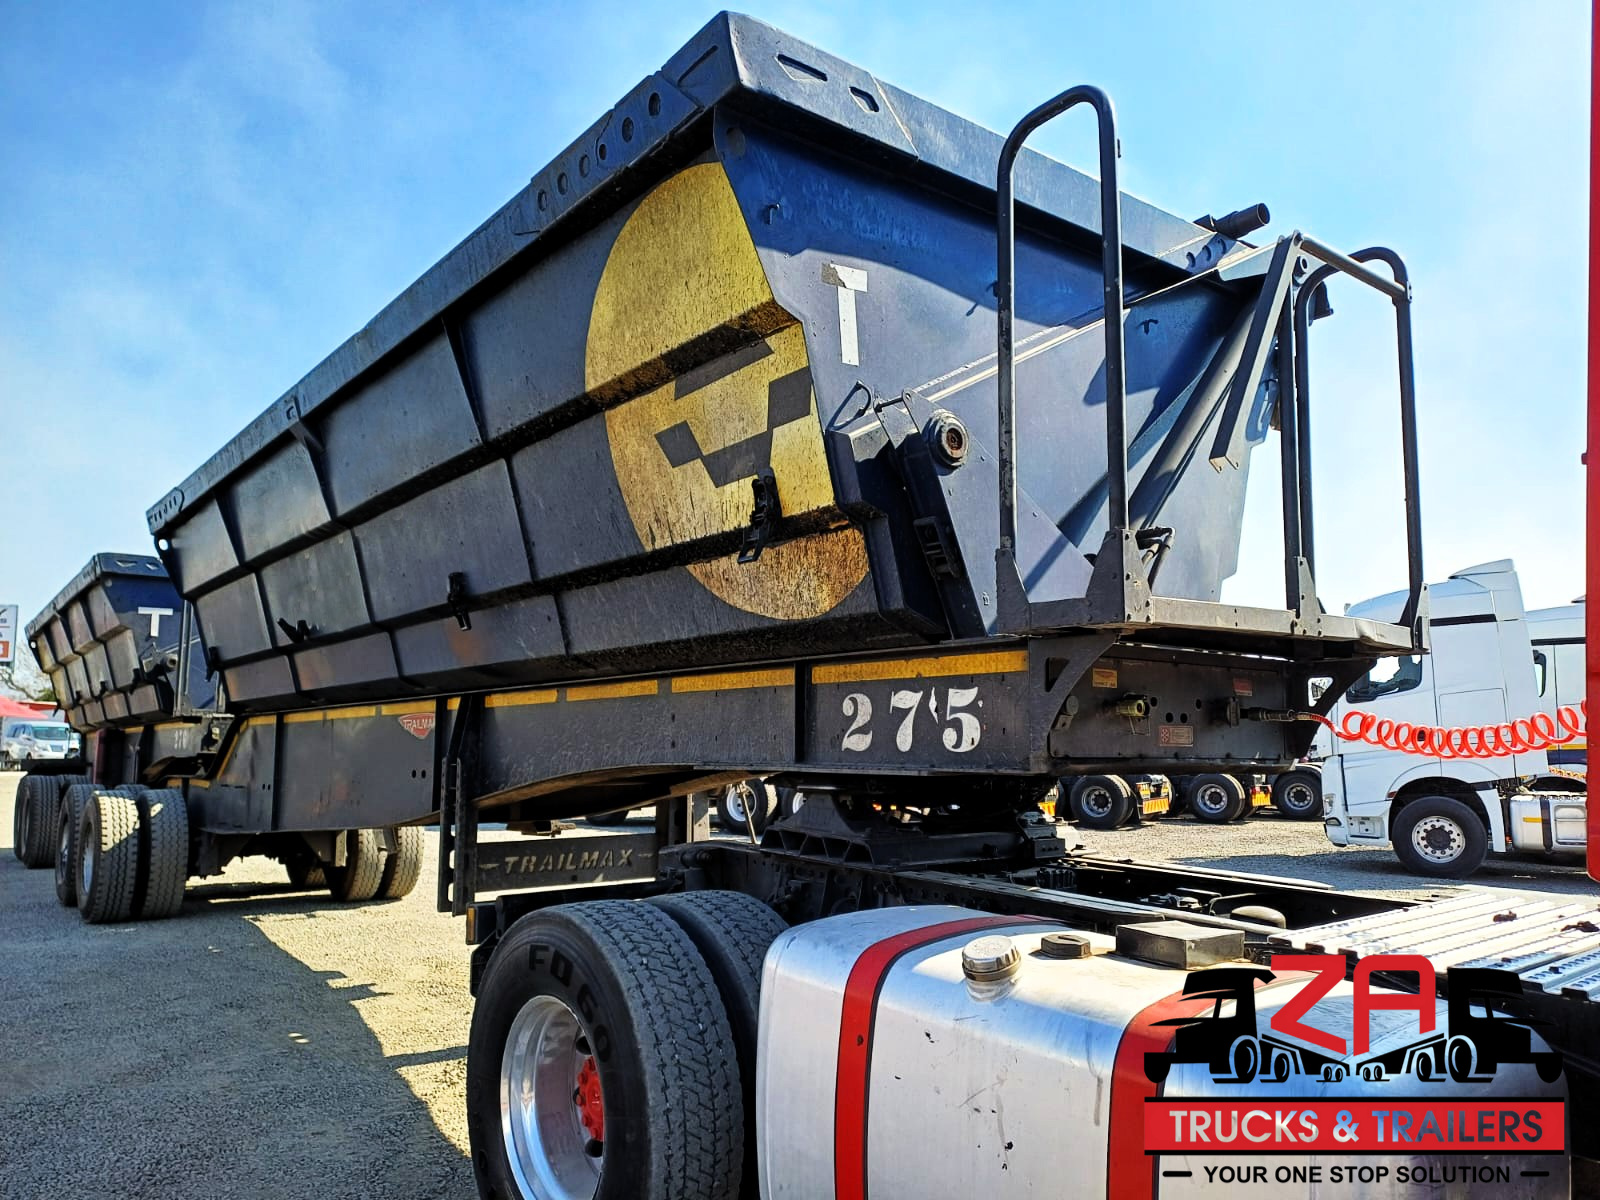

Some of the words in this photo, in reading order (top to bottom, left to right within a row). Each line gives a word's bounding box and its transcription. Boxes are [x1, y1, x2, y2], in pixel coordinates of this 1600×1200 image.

[822, 262, 868, 366] T
[137, 606, 174, 637] T
[841, 686, 982, 753] 275
[504, 848, 633, 874] TRAILMAX
